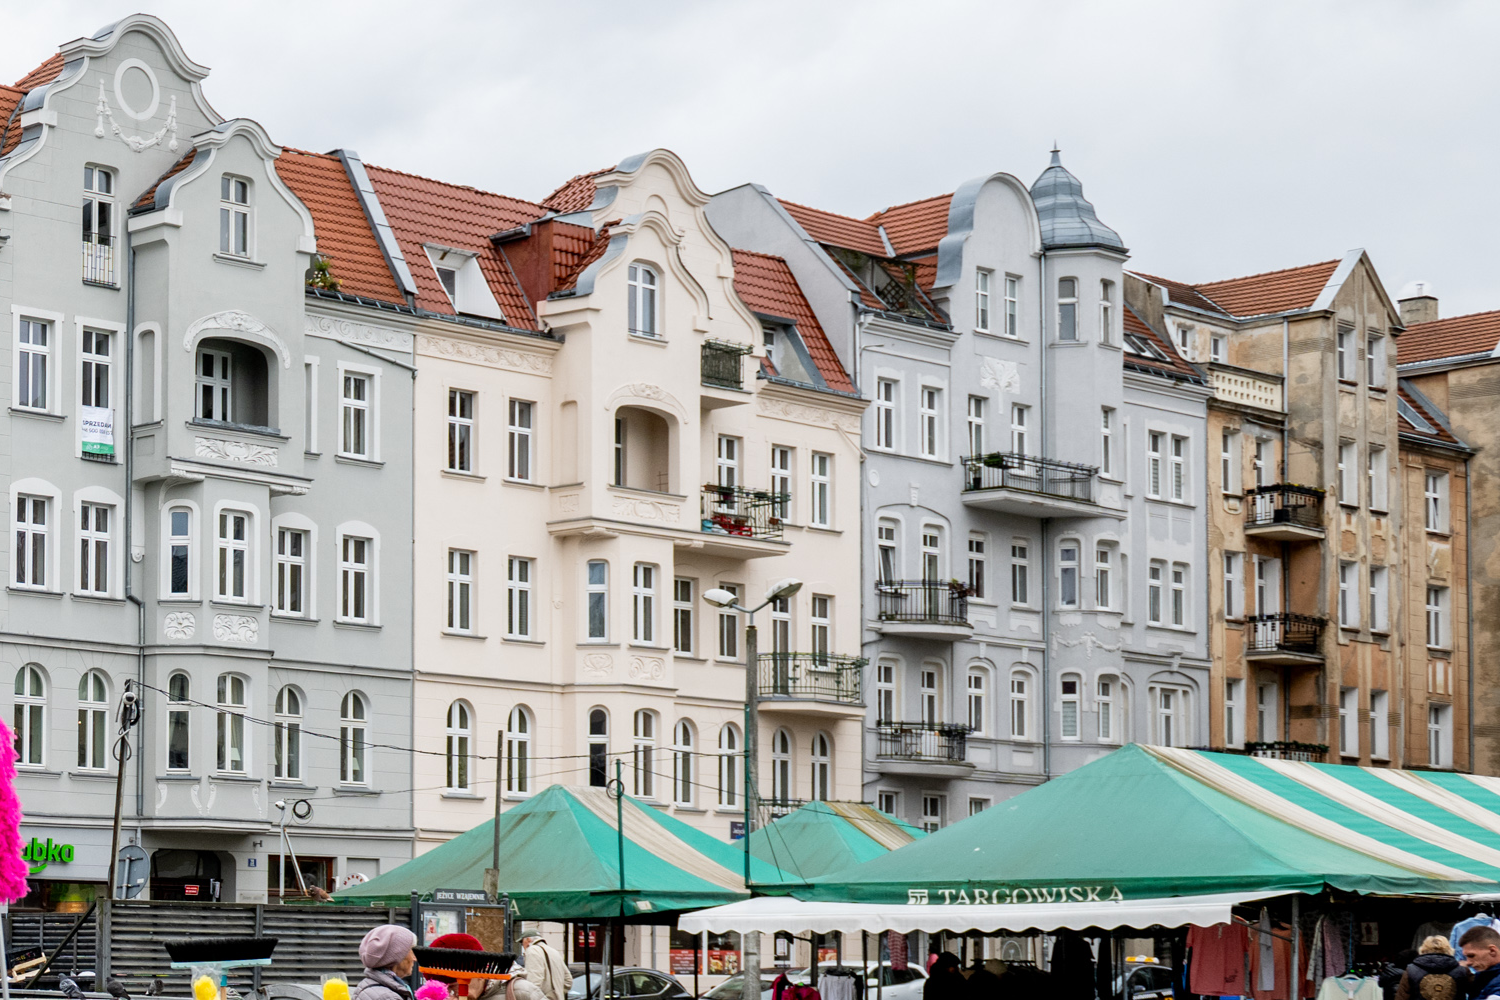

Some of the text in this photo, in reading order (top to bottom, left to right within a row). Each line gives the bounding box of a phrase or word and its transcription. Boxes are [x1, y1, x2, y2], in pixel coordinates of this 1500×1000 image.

[21, 837, 74, 862] abka
[437, 890, 486, 901] JEŻYCE WZAJEMNIE
[938, 886, 1122, 904] TARGOWISKA
